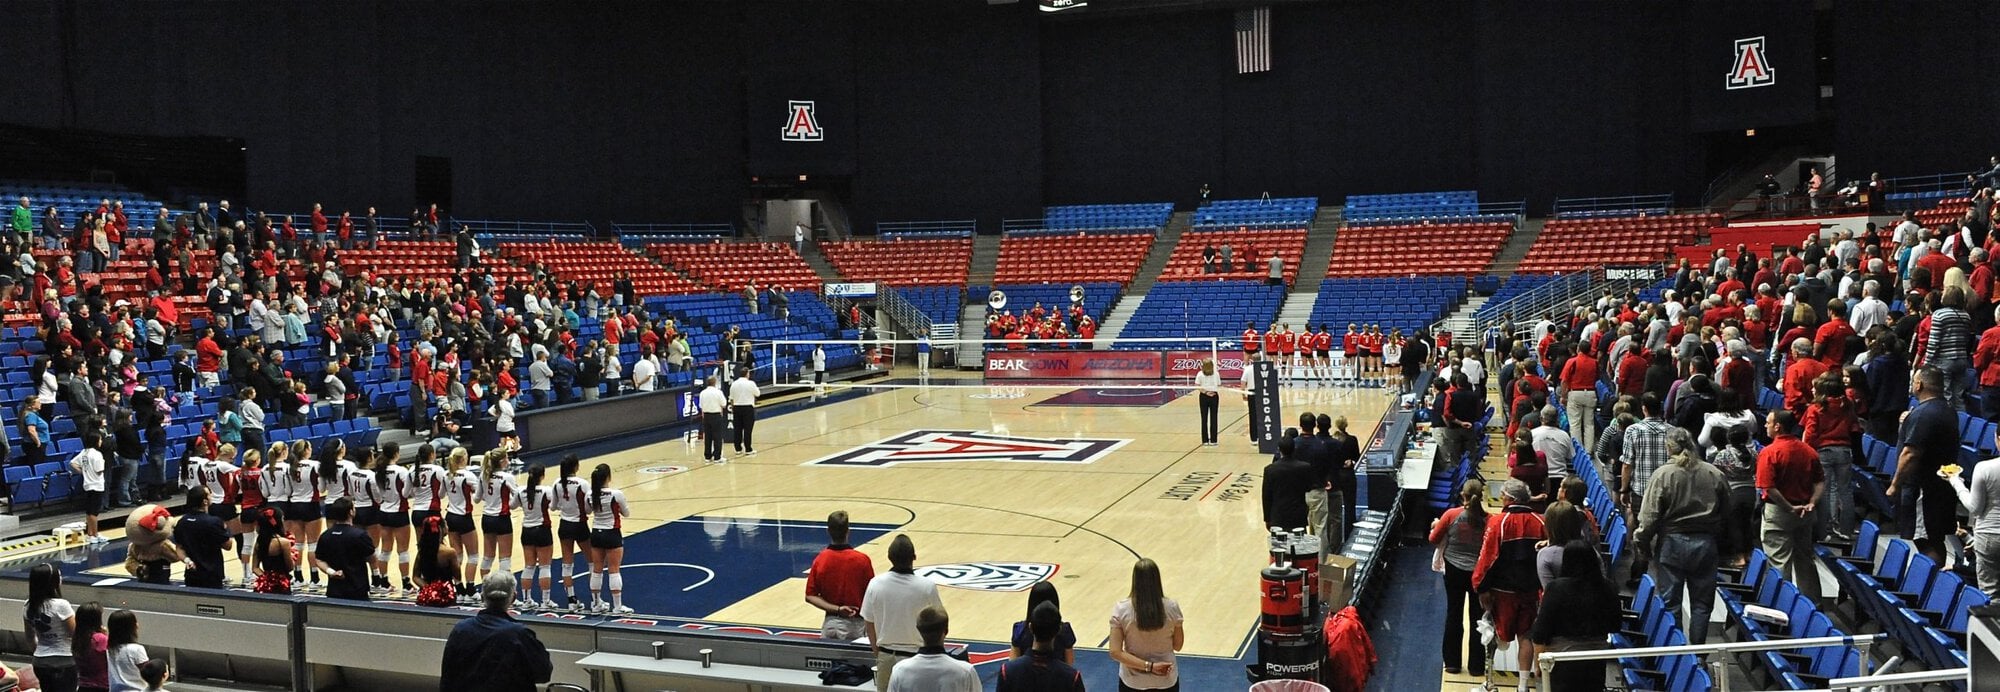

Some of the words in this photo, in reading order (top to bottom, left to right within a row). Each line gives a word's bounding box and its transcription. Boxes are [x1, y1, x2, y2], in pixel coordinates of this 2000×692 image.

[1726, 36, 1775, 90] A
[782, 100, 823, 141] A
[989, 359, 1029, 371] BEAR
[1260, 371, 1272, 440] WILDCATS
[487, 482, 494, 495] 5
